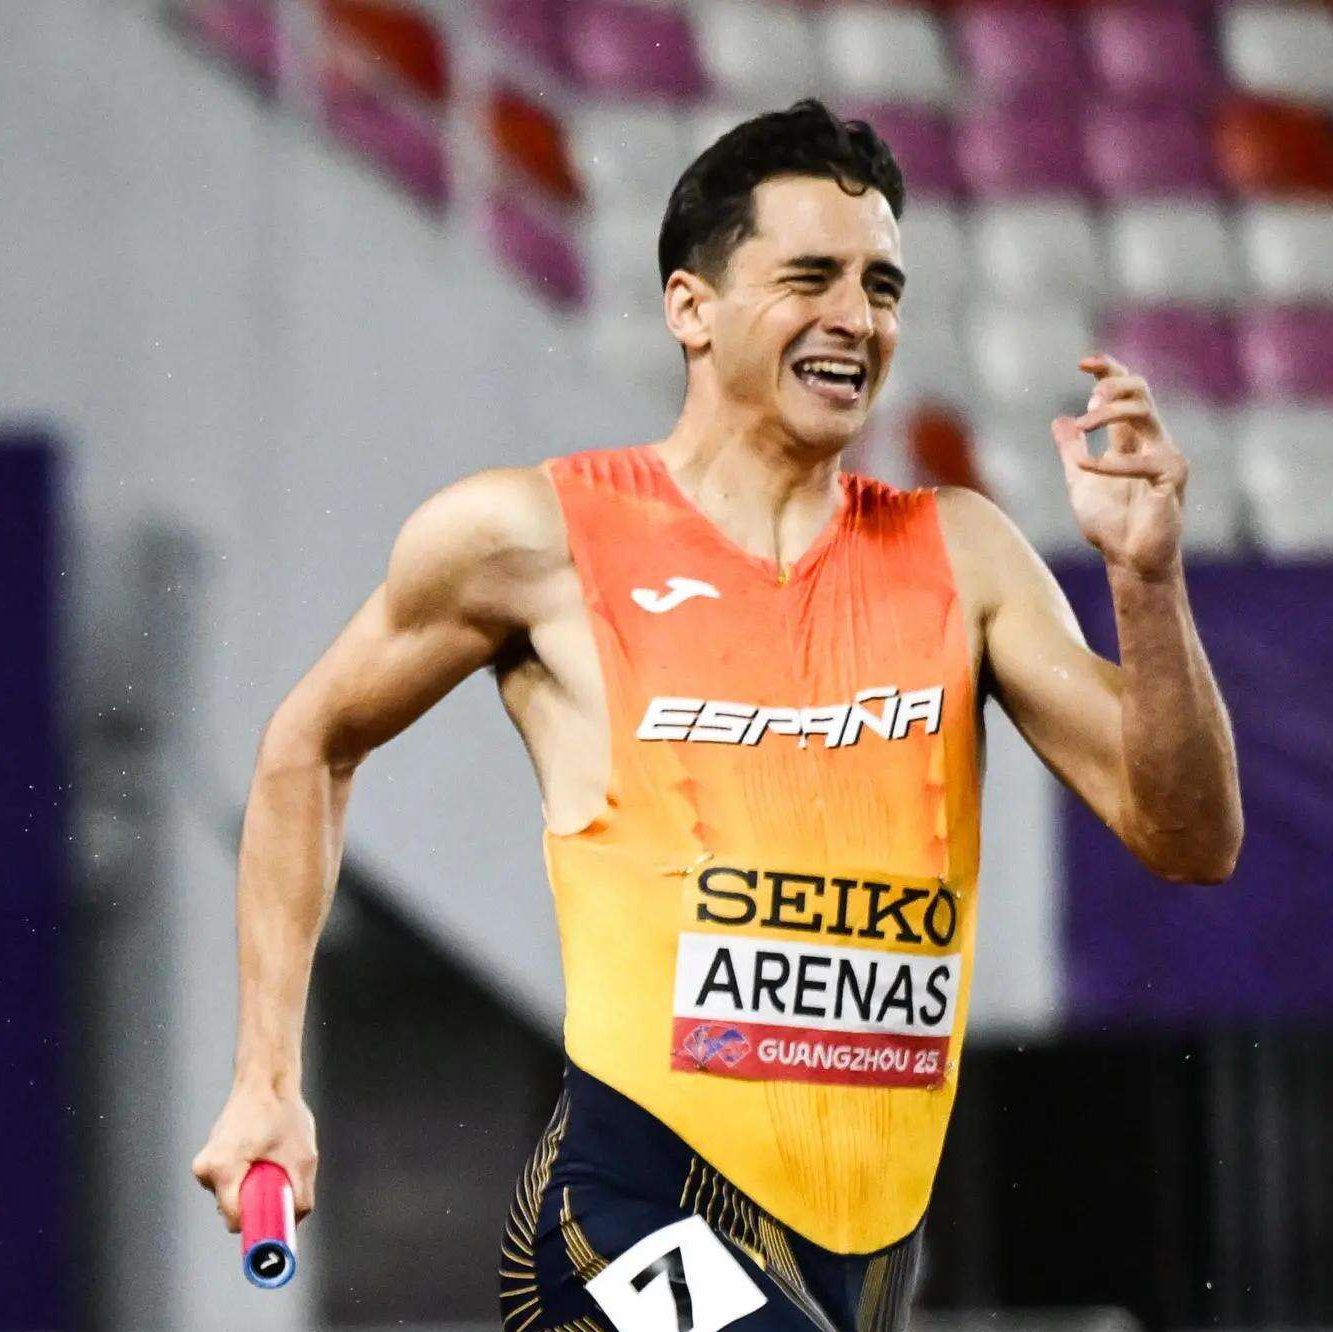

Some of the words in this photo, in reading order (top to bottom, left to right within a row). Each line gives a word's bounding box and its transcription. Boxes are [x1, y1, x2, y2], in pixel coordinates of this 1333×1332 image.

[636, 686, 945, 748] ESPAÑA
[697, 867, 959, 947] SEIKO
[695, 947, 951, 1028] ARENAS
[756, 1037, 910, 1072] GUANGZHOU
[912, 1050, 940, 1074] 25
